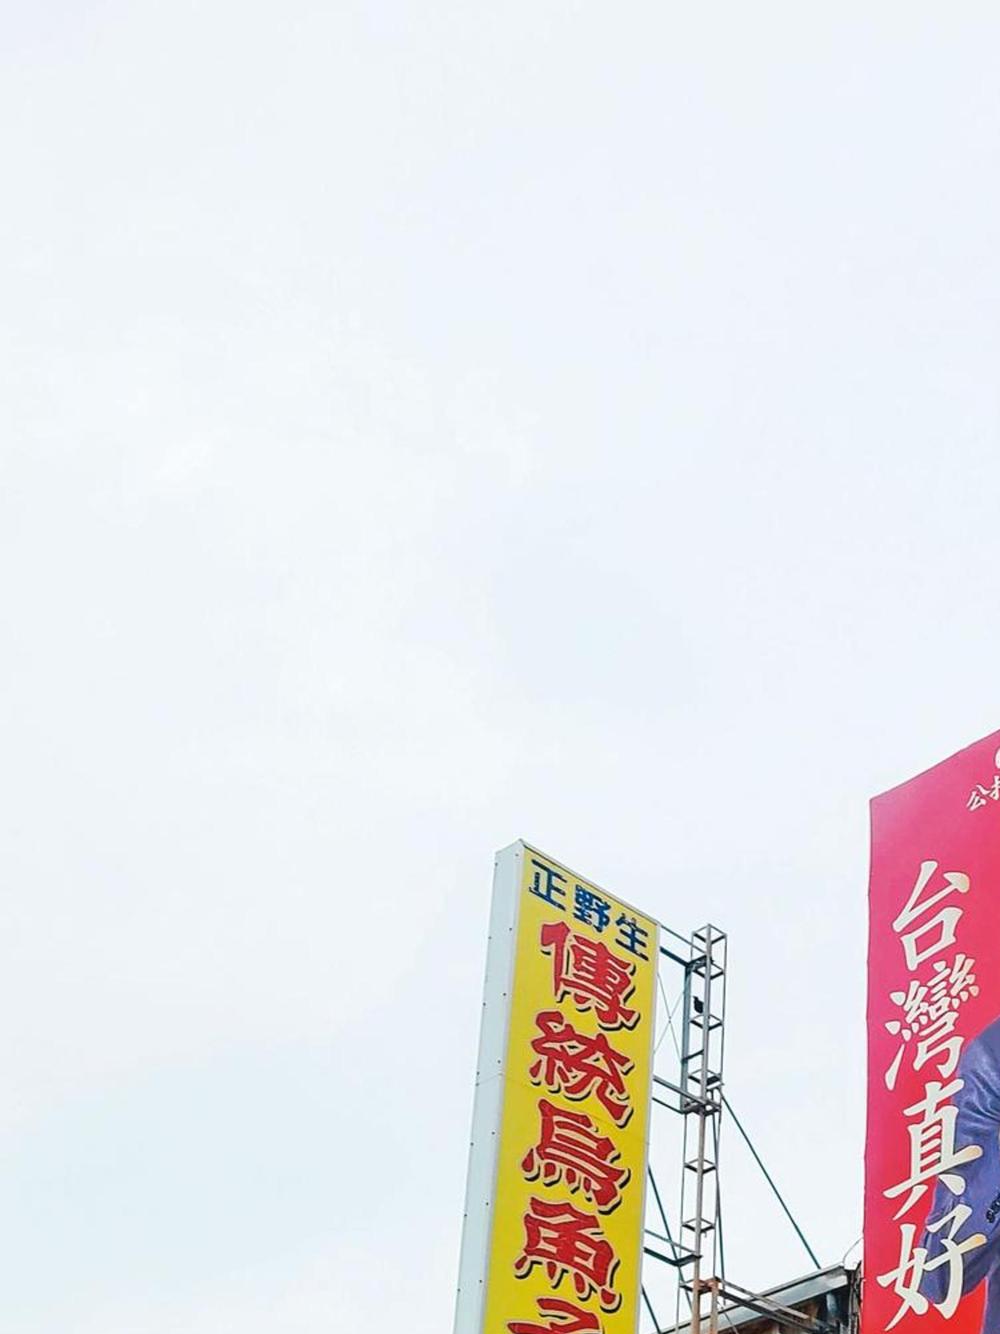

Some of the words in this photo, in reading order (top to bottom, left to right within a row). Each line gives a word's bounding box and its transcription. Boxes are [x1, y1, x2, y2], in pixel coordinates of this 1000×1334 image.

[529, 859, 649, 962] 正野生
[876, 859, 987, 1332] 台灣真好
